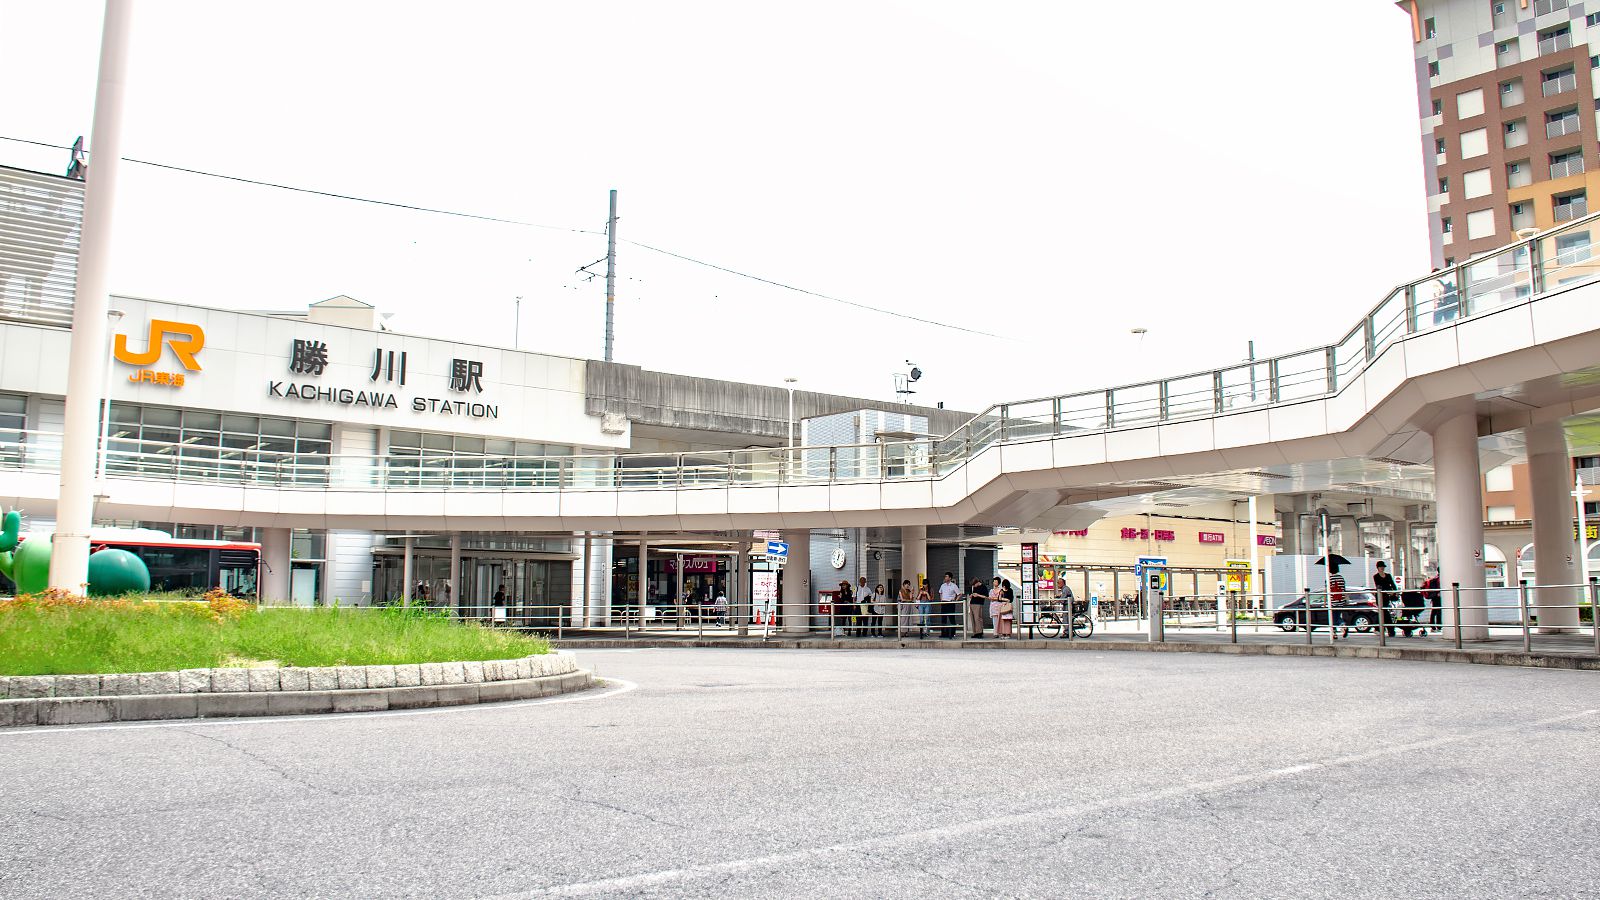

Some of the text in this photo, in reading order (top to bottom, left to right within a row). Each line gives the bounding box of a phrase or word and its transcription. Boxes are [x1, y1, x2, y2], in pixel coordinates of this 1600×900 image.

[114, 319, 204, 370] JR
[289, 338, 483, 393] 勝川駅
[128, 369, 185, 387] JR東海
[268, 380, 499, 419] KACHIGAWA STATION
